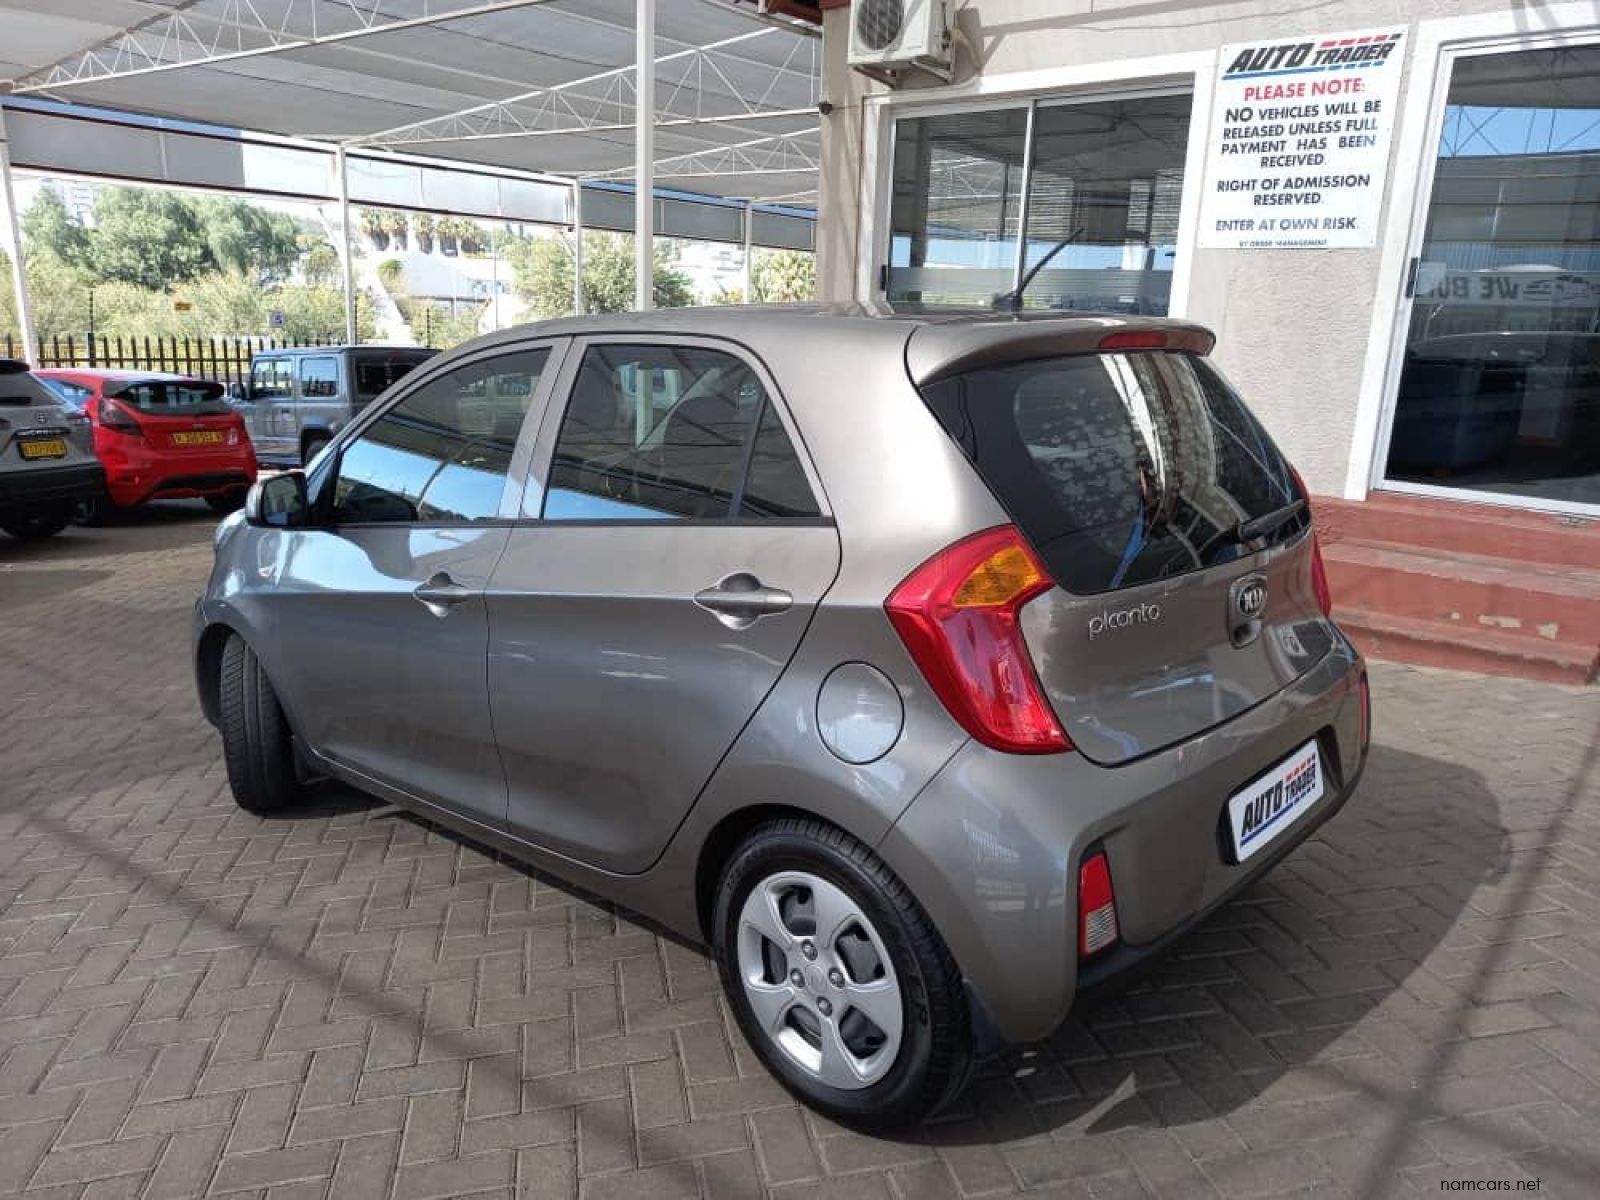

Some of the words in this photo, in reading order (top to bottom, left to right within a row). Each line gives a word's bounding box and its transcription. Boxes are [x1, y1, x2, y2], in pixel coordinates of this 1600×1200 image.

[1226, 43, 1315, 73] AUTO
[1311, 42, 1396, 66] TRADER
[1244, 83, 1305, 101] PLEASE
[1311, 78, 1365, 95] NOTE:
[1225, 107, 1253, 123] NO
[1259, 104, 1319, 121] VEHICLES
[1325, 101, 1358, 116] WILL
[1364, 100, 1382, 113] BE
[1223, 125, 1284, 140] RELEASED
[1289, 120, 1341, 136] UNLESS
[1346, 118, 1378, 131] FULL
[1221, 140, 1287, 155] PAYMENT
[1297, 138, 1327, 151] HAS
[1339, 134, 1376, 148] BEEN
[1217, 179, 1257, 192] RIGHT
[1261, 178, 1281, 190] OF
[1283, 174, 1370, 190] ADMISSION
[1215, 219, 1255, 232] ENTER
[1258, 218, 1276, 231] AT
[1279, 218, 1319, 231] OWN
[1241, 779, 1284, 838] AUTO
